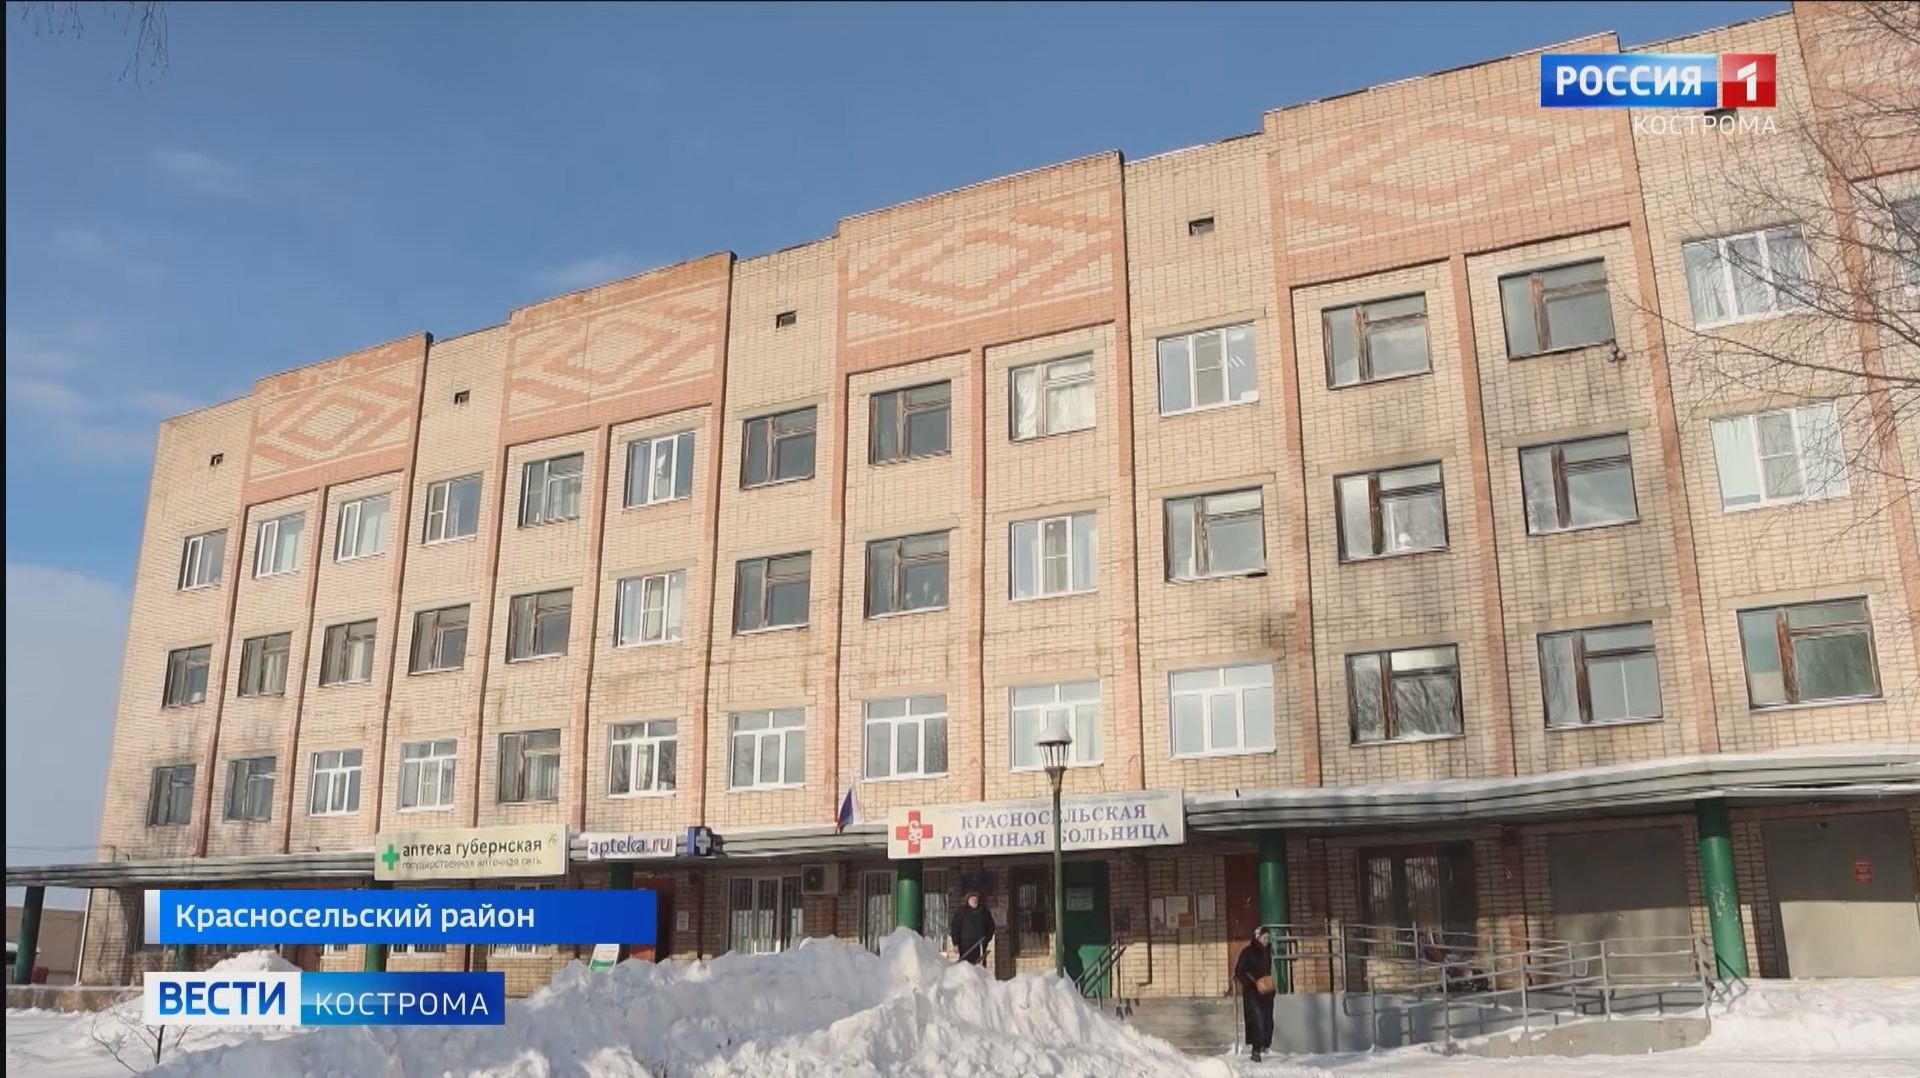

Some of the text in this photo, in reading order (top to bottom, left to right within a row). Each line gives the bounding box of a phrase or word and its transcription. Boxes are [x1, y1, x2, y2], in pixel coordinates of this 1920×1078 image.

[961, 804, 1147, 830] КРАСНОСЛЬСКАЯ
[402, 838, 542, 858] аптека губернская
[590, 835, 673, 860] apteka.ru
[941, 830, 1046, 850] РАЙОННАЯ
